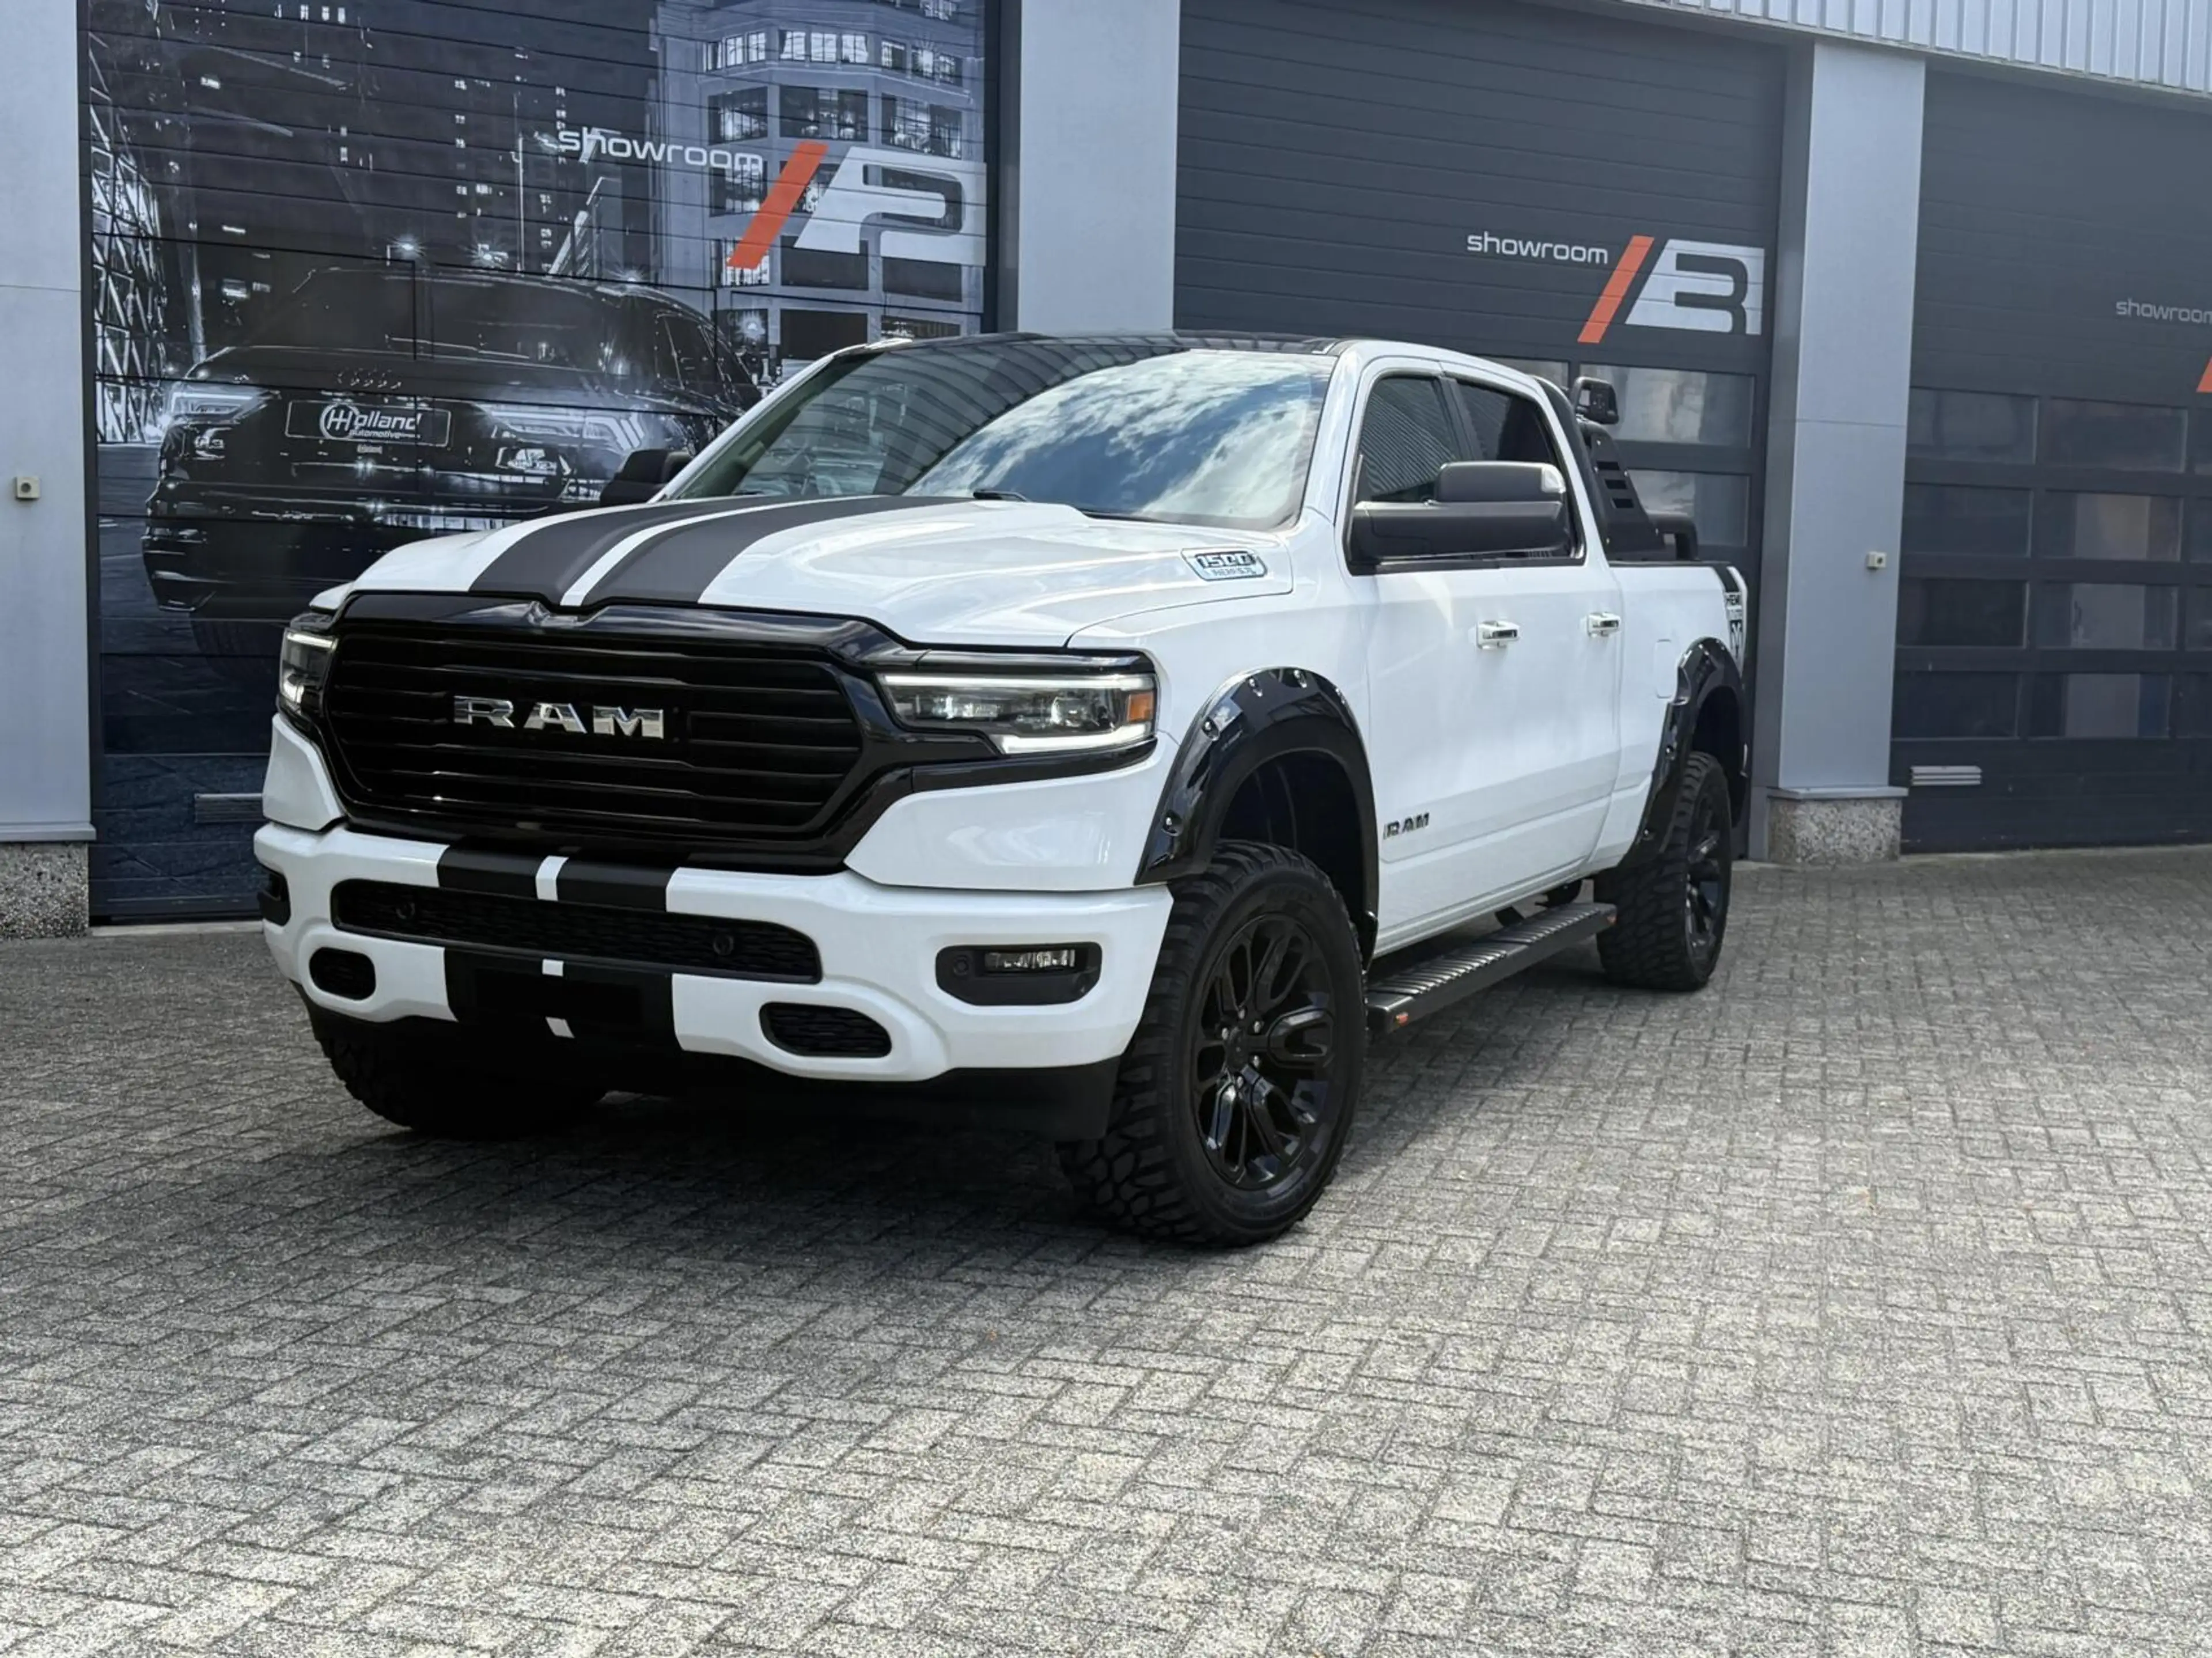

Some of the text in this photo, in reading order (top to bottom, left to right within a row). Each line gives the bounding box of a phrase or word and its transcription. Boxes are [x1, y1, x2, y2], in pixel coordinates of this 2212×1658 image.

[558, 127, 763, 174] showroom
[1467, 231, 1608, 264] showroom
[350, 428, 400, 439] automotive
[1196, 552, 1256, 568] 1500
[453, 695, 664, 739] RAM
[1383, 812, 1430, 840] RAM
